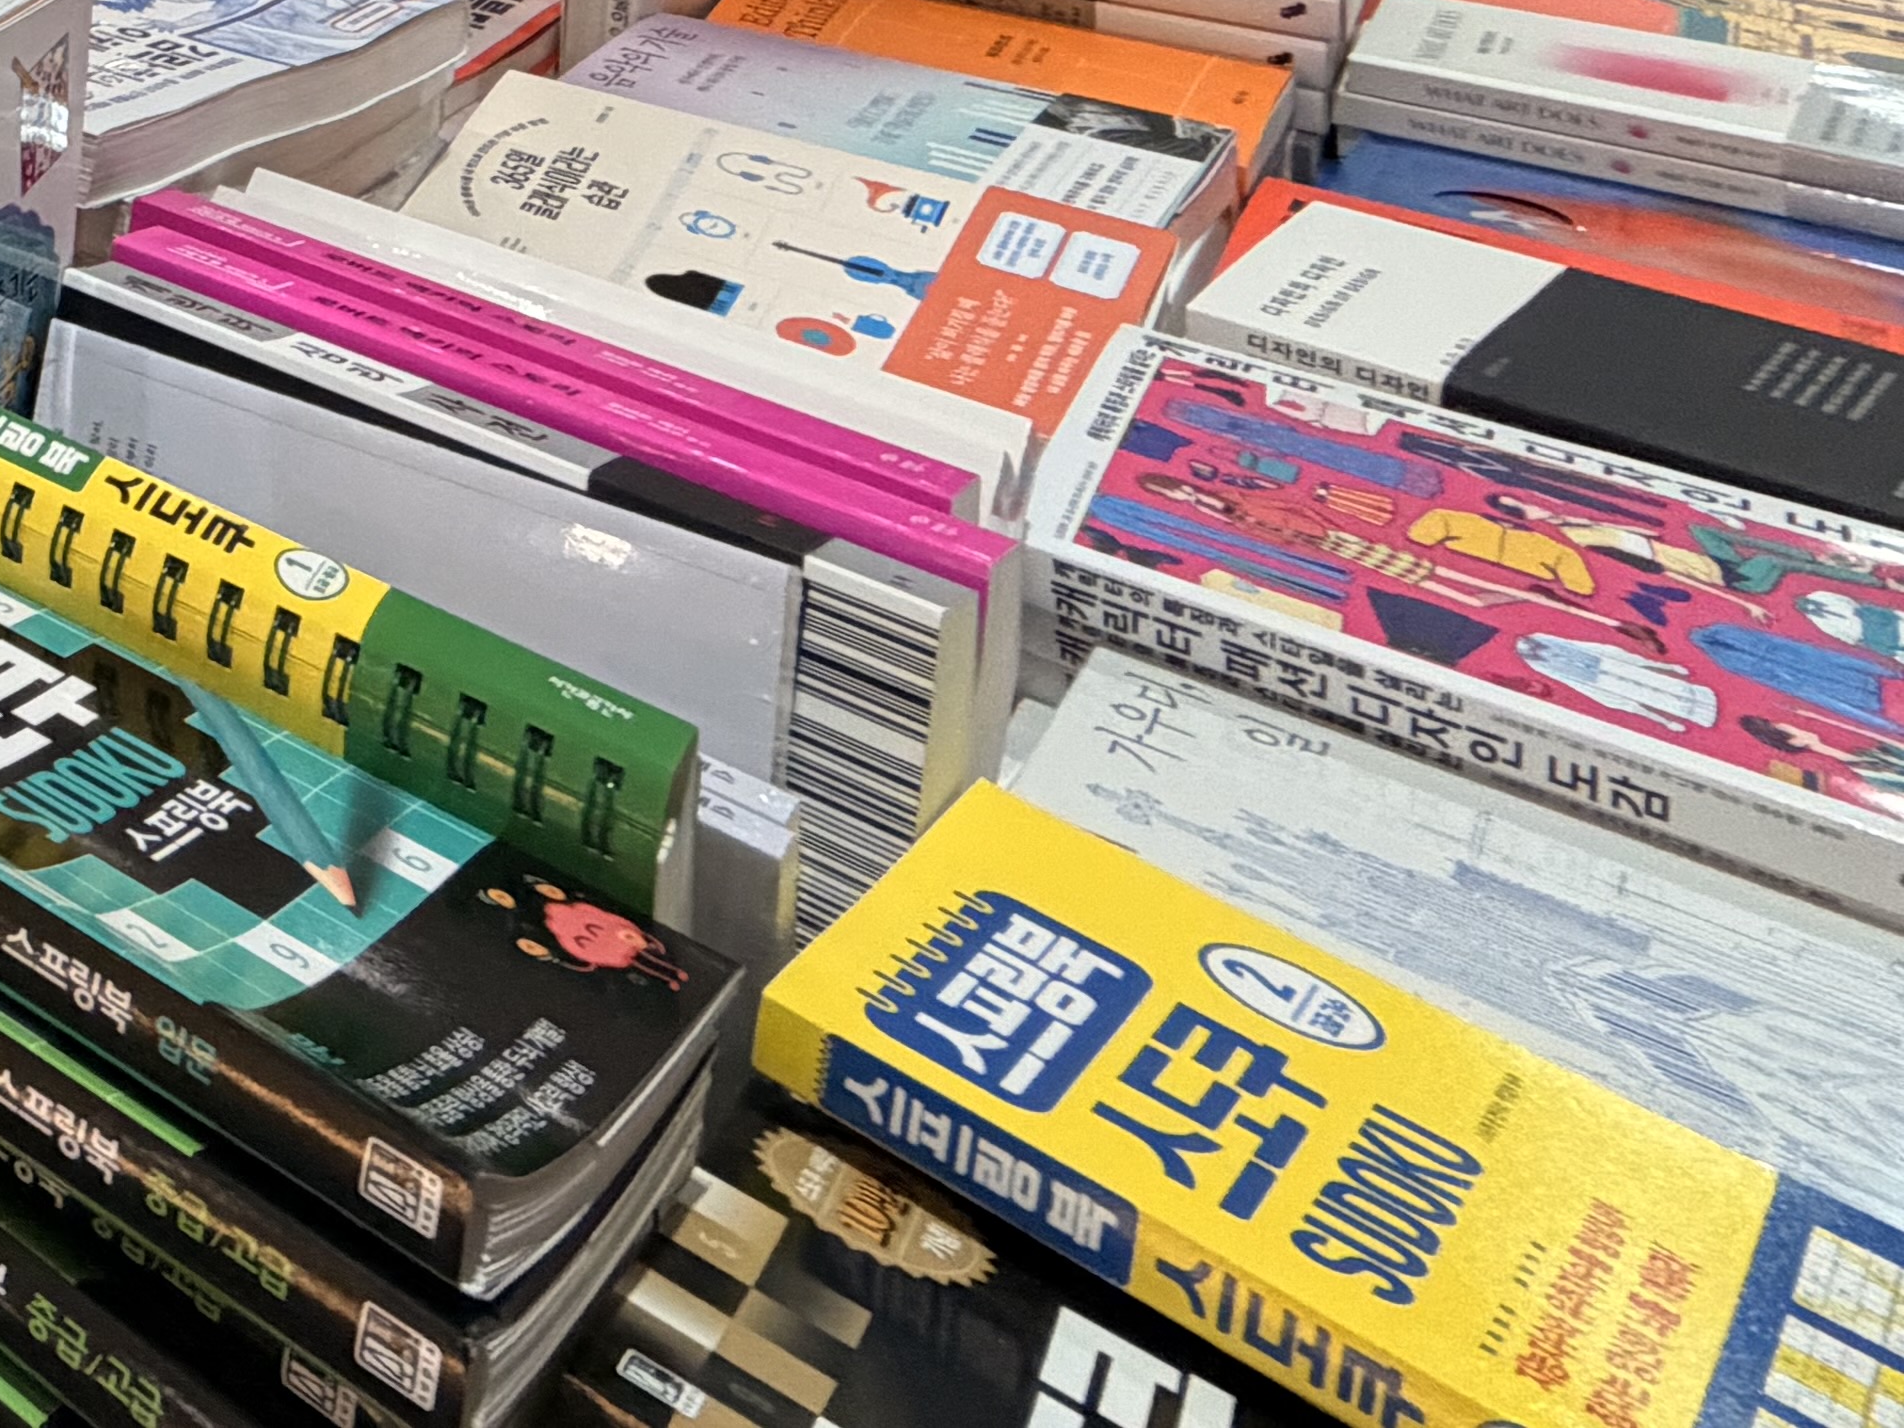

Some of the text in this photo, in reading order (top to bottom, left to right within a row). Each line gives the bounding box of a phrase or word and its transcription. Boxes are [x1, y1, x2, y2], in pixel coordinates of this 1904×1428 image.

[489, 147, 546, 192] 365일
[519, 146, 600, 223] 클래식이라는
[580, 178, 630, 211] 습관
[1247, 331, 1435, 404] 디자인의 디자인
[104, 472, 257, 554] 스도쿠
[1053, 580, 1673, 824] 캐릭터 패션 디자인 도감
[125, 779, 256, 864] 스프링북
[0, 926, 134, 1036] 스프링북
[912, 911, 1126, 1097] 스프링북
[1220, 957, 1298, 1007] 2
[844, 1075, 1122, 1253] 스프링북
[1091, 1000, 1329, 1224] 스도쿠
[144, 1166, 296, 1302] 중급/고급
[1290, 1103, 1485, 1307] SUDOKU
[25, 1291, 166, 1428] 중급/고급
[1155, 1249, 1429, 1428] 스도쿠
